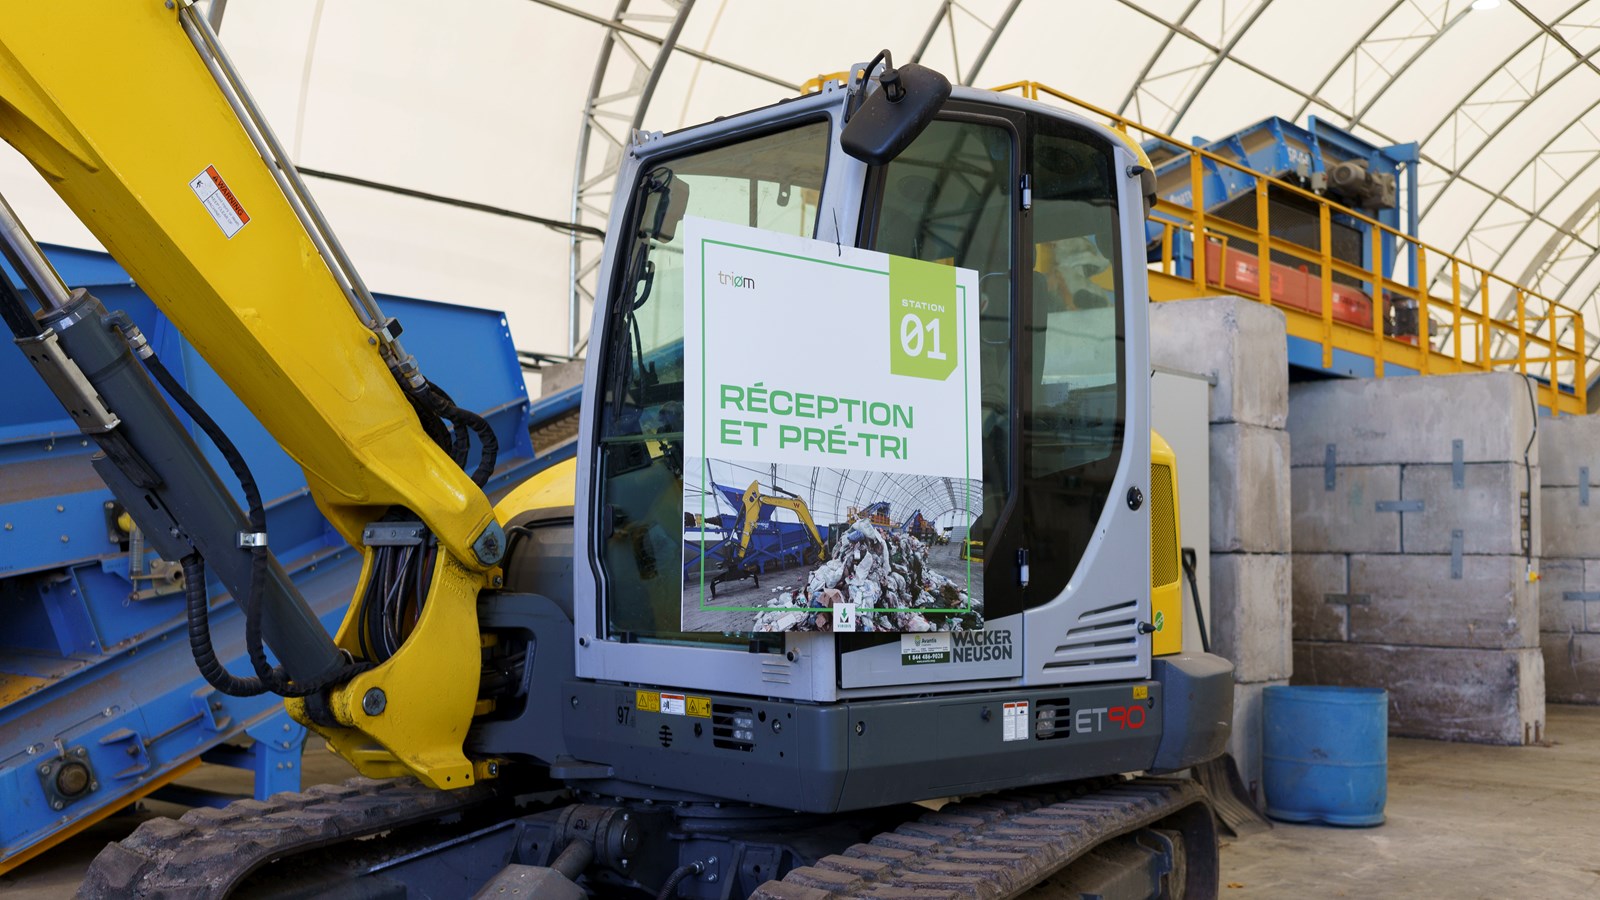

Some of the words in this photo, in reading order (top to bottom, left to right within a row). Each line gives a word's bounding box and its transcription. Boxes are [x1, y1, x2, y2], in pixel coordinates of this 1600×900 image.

[217, 181, 243, 216] WARNING
[901, 299, 945, 313] STATION
[900, 313, 947, 360] 01
[720, 382, 914, 429] RÉCEPTION
[720, 419, 768, 447] ET
[779, 424, 908, 460] PRÉ-TRI
[952, 630, 1012, 647] WACKER
[953, 645, 1012, 663] NEUSON
[617, 705, 630, 725] 97
[1075, 705, 1146, 733] ET90
